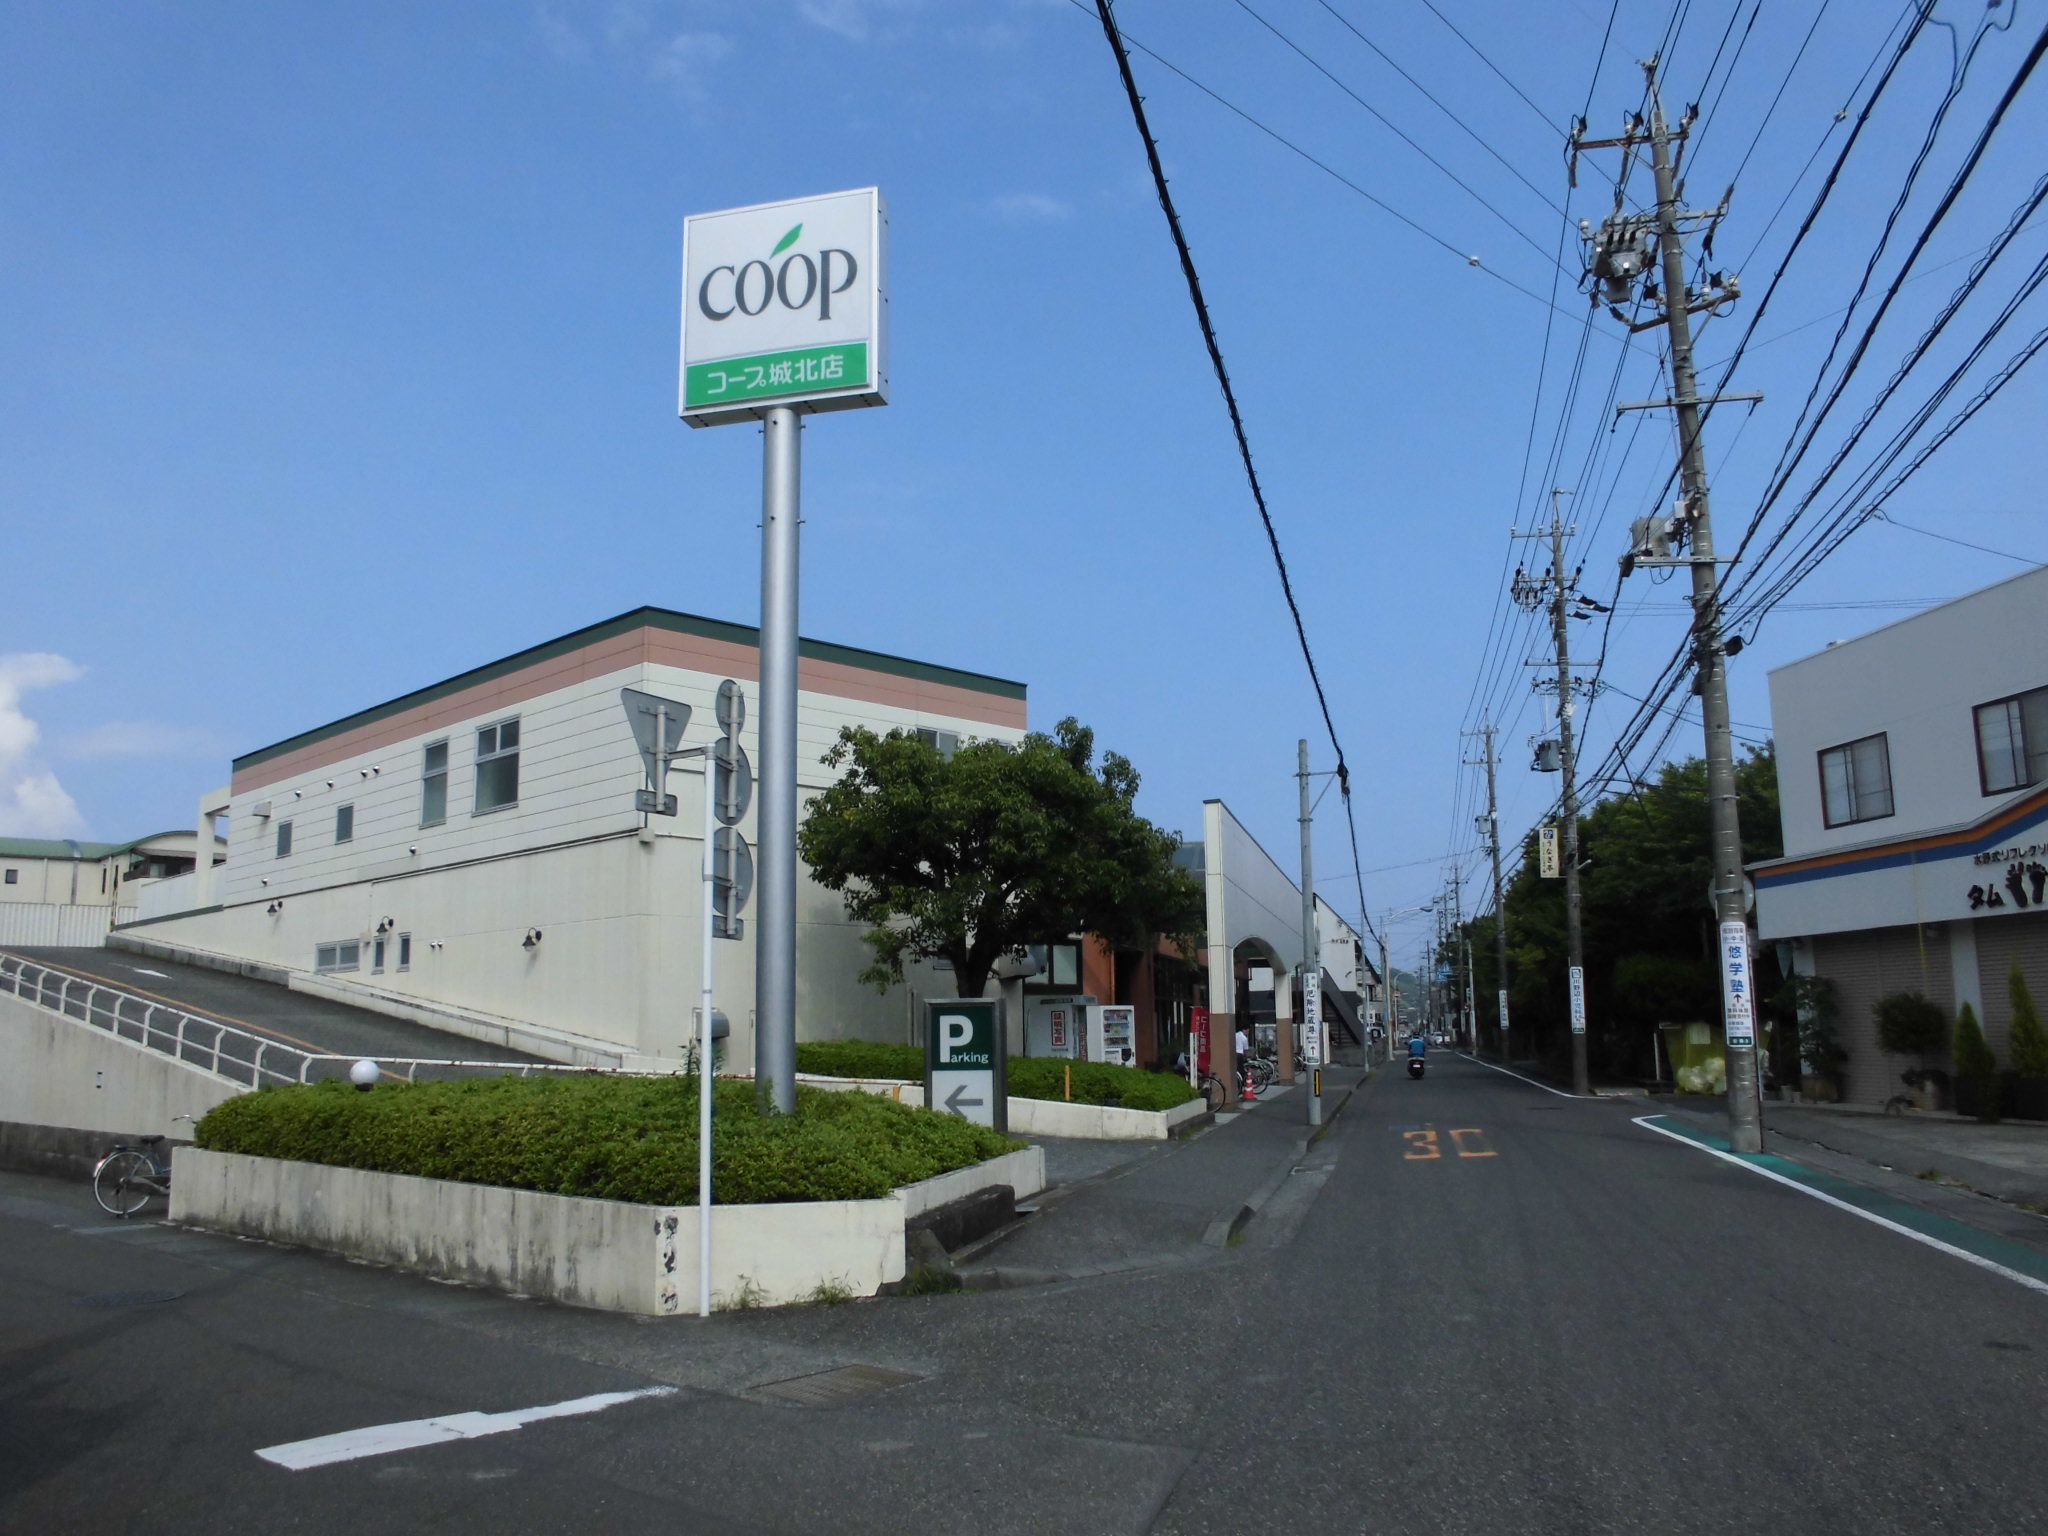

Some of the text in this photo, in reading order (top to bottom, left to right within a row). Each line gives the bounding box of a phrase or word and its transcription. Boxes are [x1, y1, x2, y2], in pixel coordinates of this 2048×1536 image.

[699, 249, 858, 321] COOP
[707, 355, 844, 394] コープ城北店
[1974, 843, 2048, 866] 水野式リフレクソ
[1967, 884, 2004, 910] タム
[1728, 945, 1744, 993] 悠学塾
